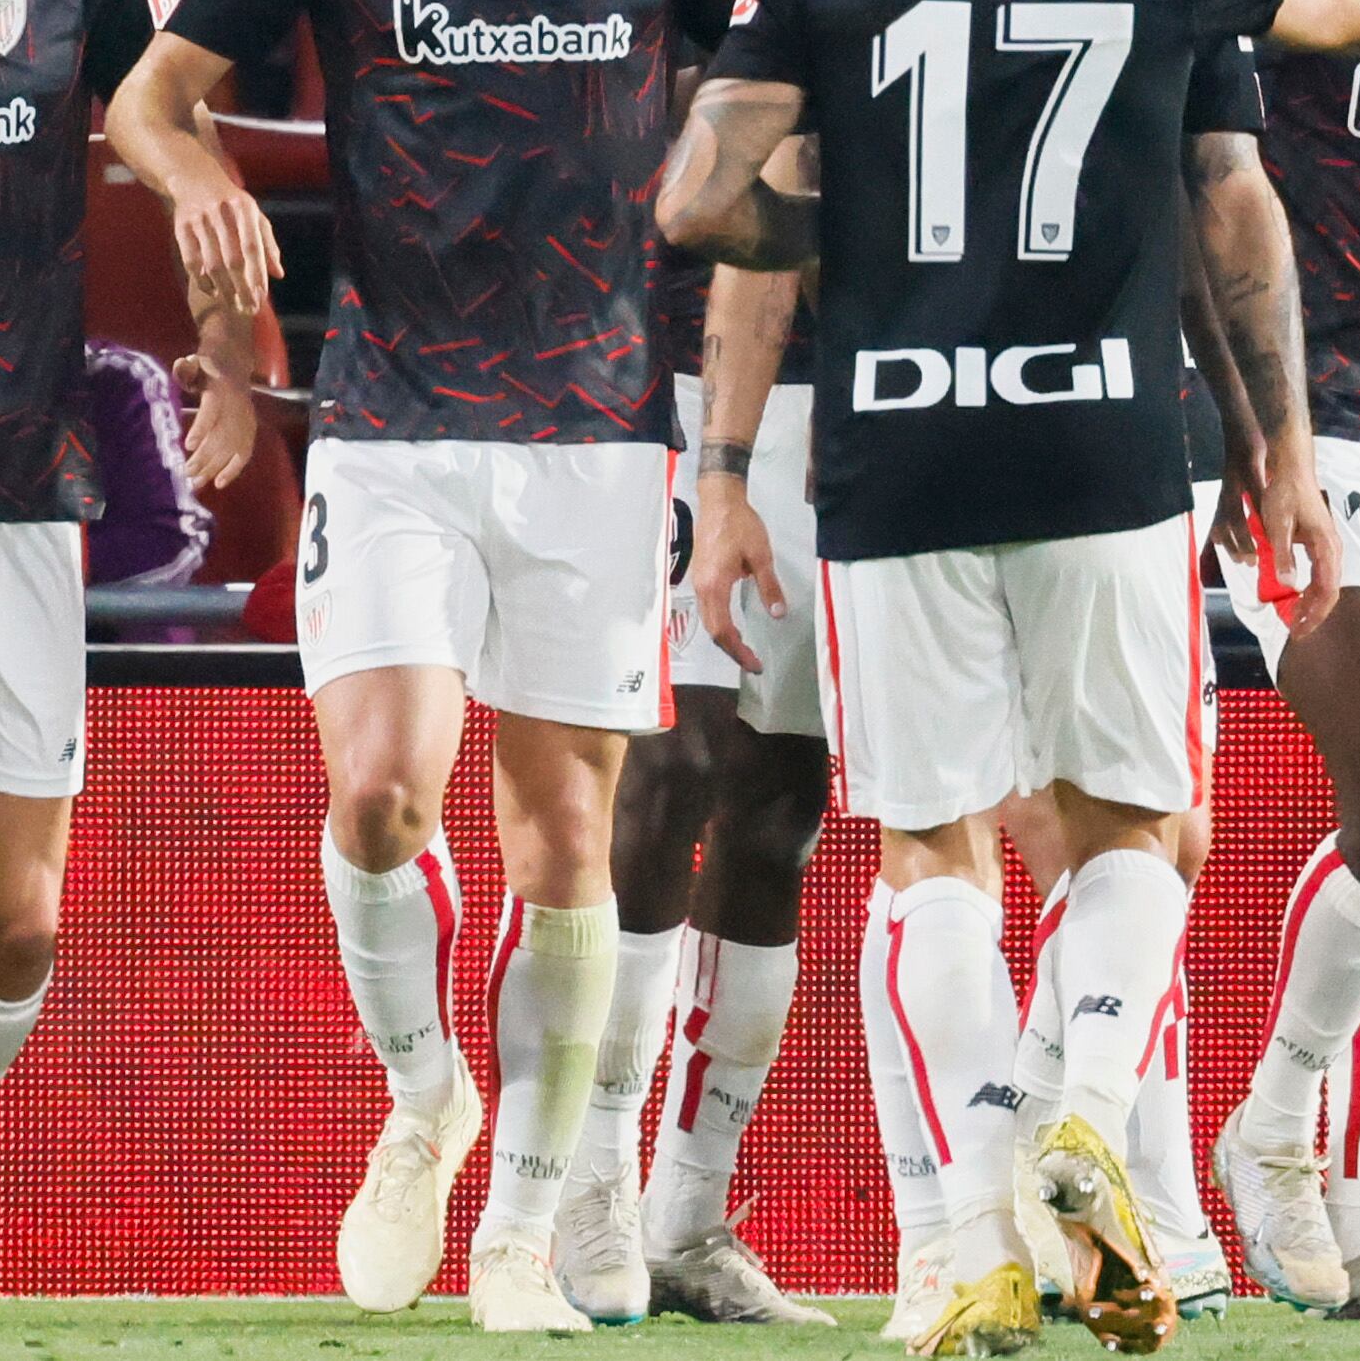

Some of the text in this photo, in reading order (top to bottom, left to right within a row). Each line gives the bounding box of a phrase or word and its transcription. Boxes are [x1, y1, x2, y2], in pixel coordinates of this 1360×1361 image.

[872, 0, 1135, 262] 17
[852, 337, 1134, 413] DIGI
[303, 491, 329, 589] 3
